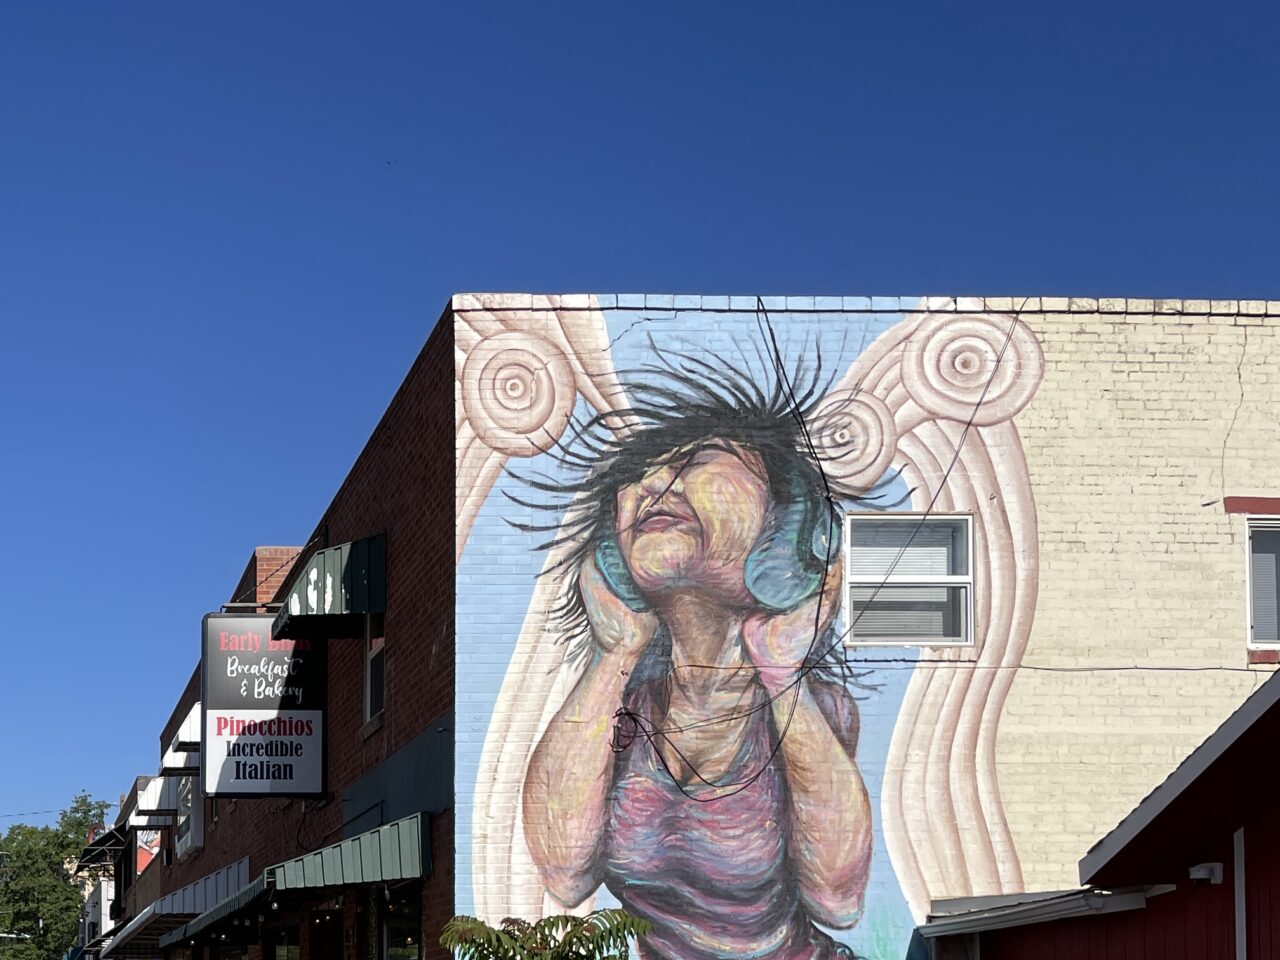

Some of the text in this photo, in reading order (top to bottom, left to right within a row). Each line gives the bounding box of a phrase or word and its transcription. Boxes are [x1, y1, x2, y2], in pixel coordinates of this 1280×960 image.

[219, 631, 261, 653] Early
[226, 655, 303, 683] Breakfast
[240, 677, 303, 705] & Bakery
[216, 716, 313, 737] Pinocchios
[226, 740, 303, 757] Incredible
[234, 761, 294, 781] Italian
